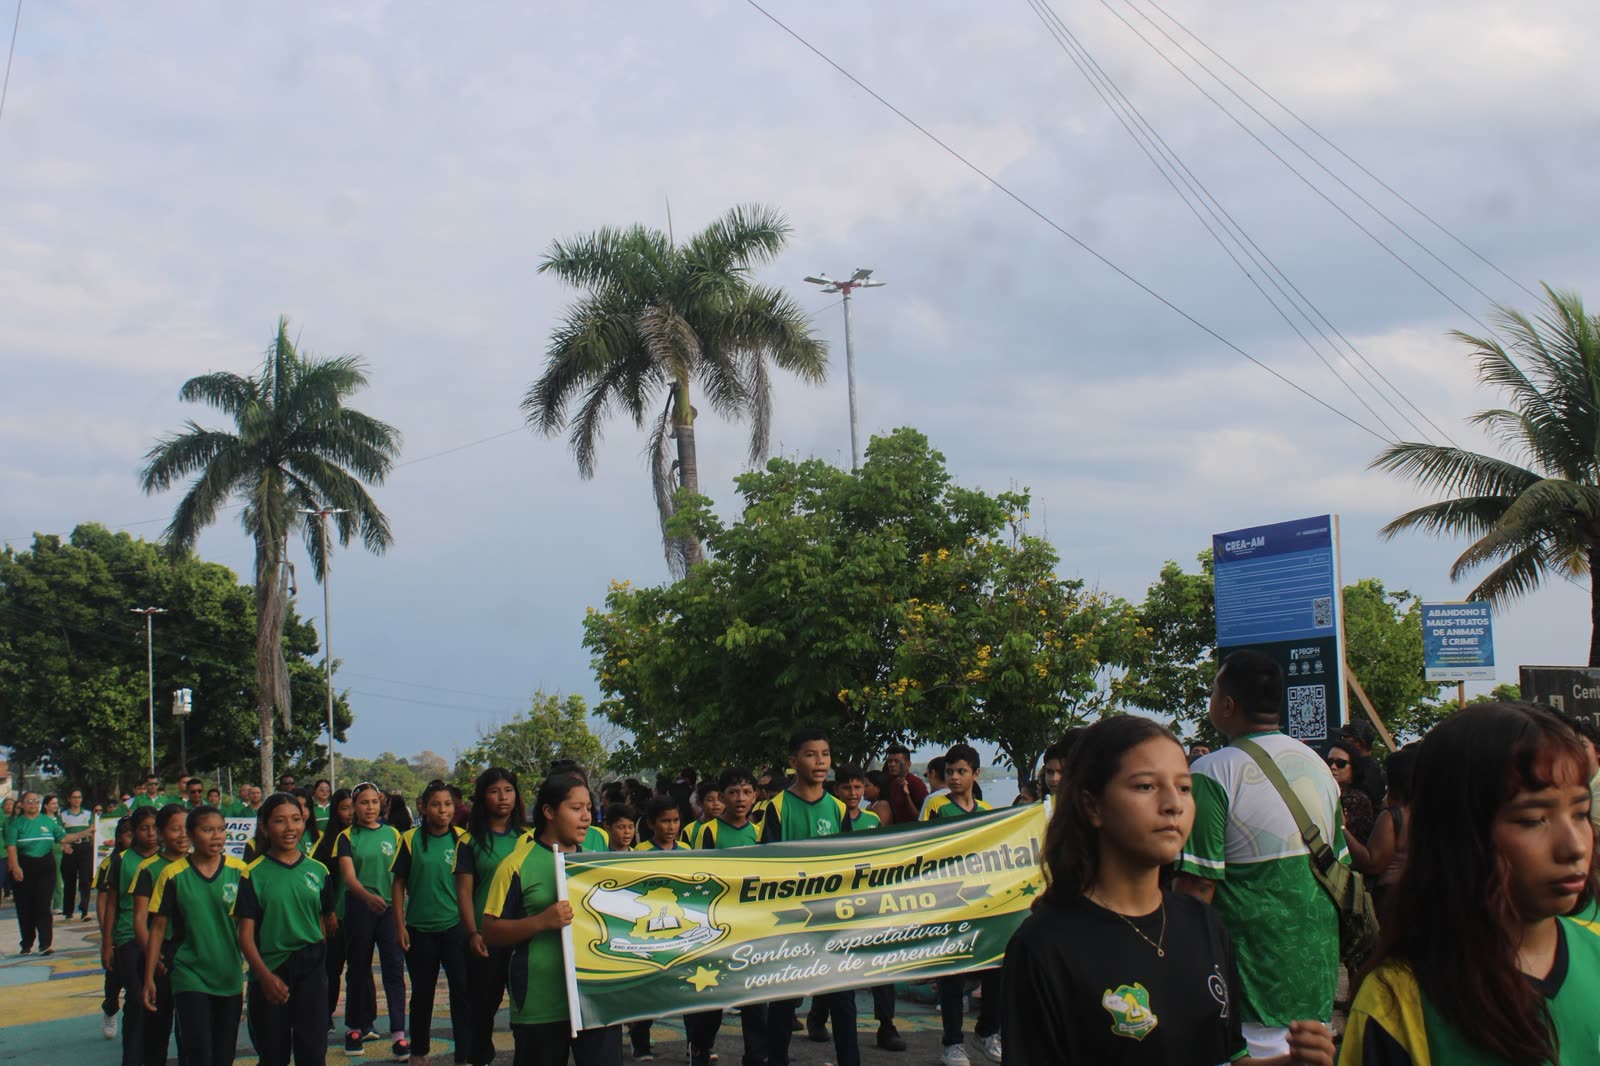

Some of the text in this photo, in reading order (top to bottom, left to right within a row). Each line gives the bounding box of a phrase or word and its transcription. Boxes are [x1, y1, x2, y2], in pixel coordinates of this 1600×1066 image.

[1225, 536, 1265, 551] CREA-AM
[1428, 608, 1487, 617] ABANDONO E
[1426, 618, 1489, 627] MAUS-TRATOS
[1432, 628, 1485, 636] DE ANIMAIS
[1441, 636, 1479, 646] É CRIME!
[739, 838, 1040, 903] Ensino Fundamental
[878, 892, 936, 914] Ano
[728, 920, 970, 971] Sonhos, expectativas e
[745, 930, 981, 989] vontade de aprender!
